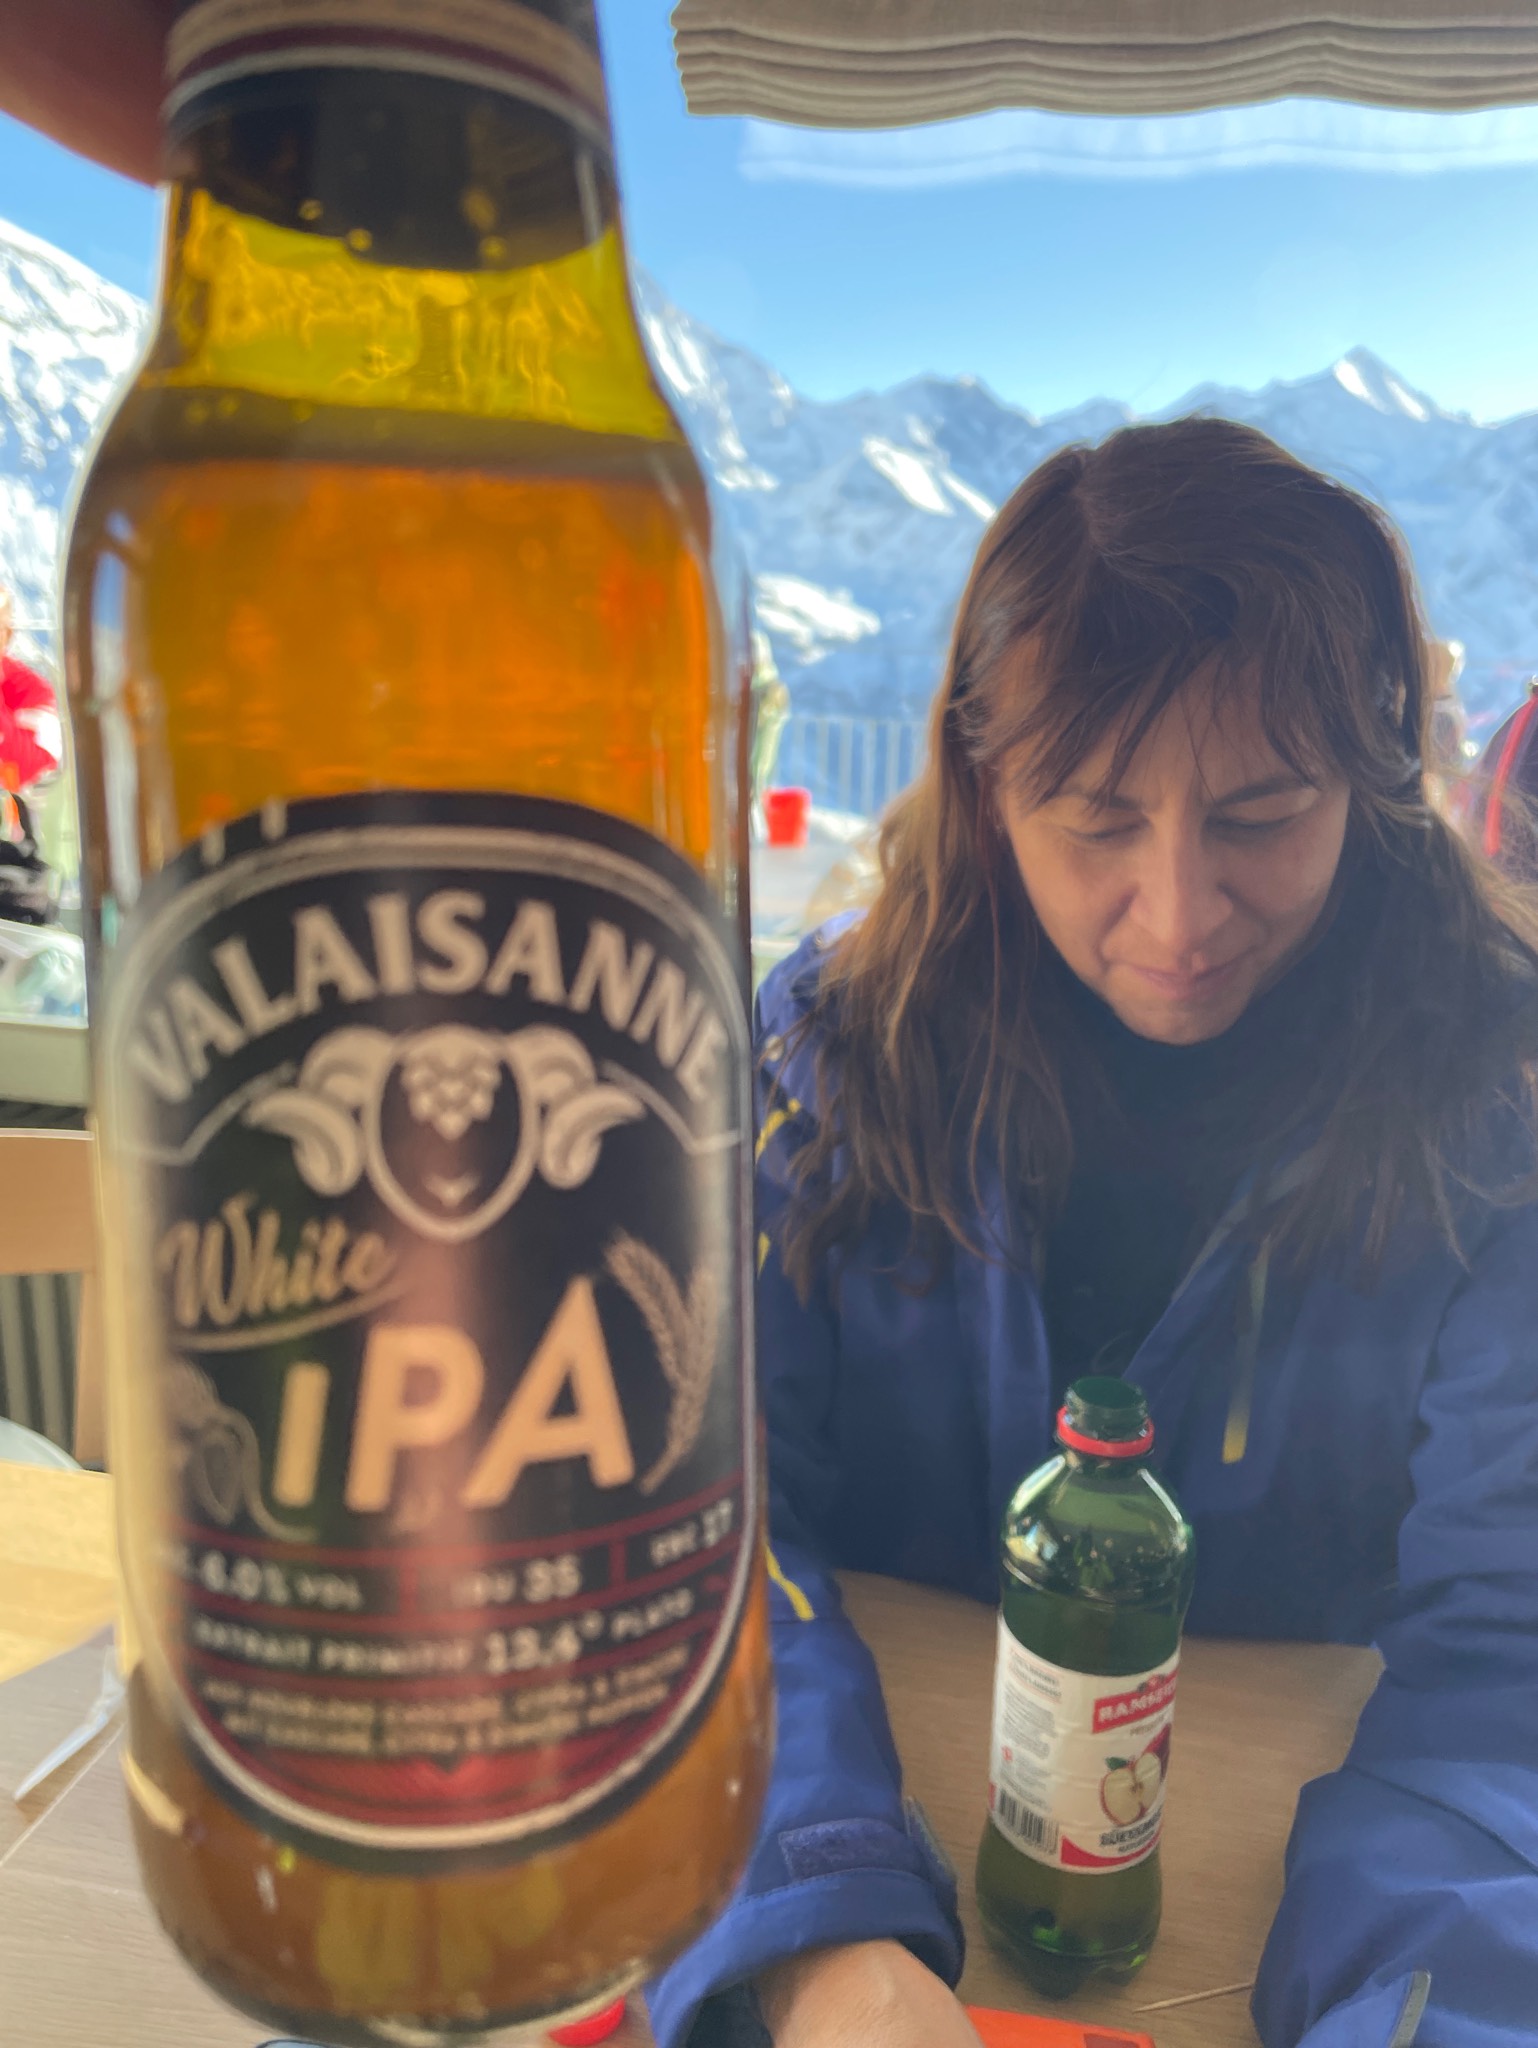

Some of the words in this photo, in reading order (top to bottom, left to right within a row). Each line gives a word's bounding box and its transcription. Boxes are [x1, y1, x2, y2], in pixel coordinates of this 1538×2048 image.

[128, 889, 728, 1102] VALAISANNE
[156, 1193, 398, 1327] White
[272, 1274, 635, 1513] IPA
